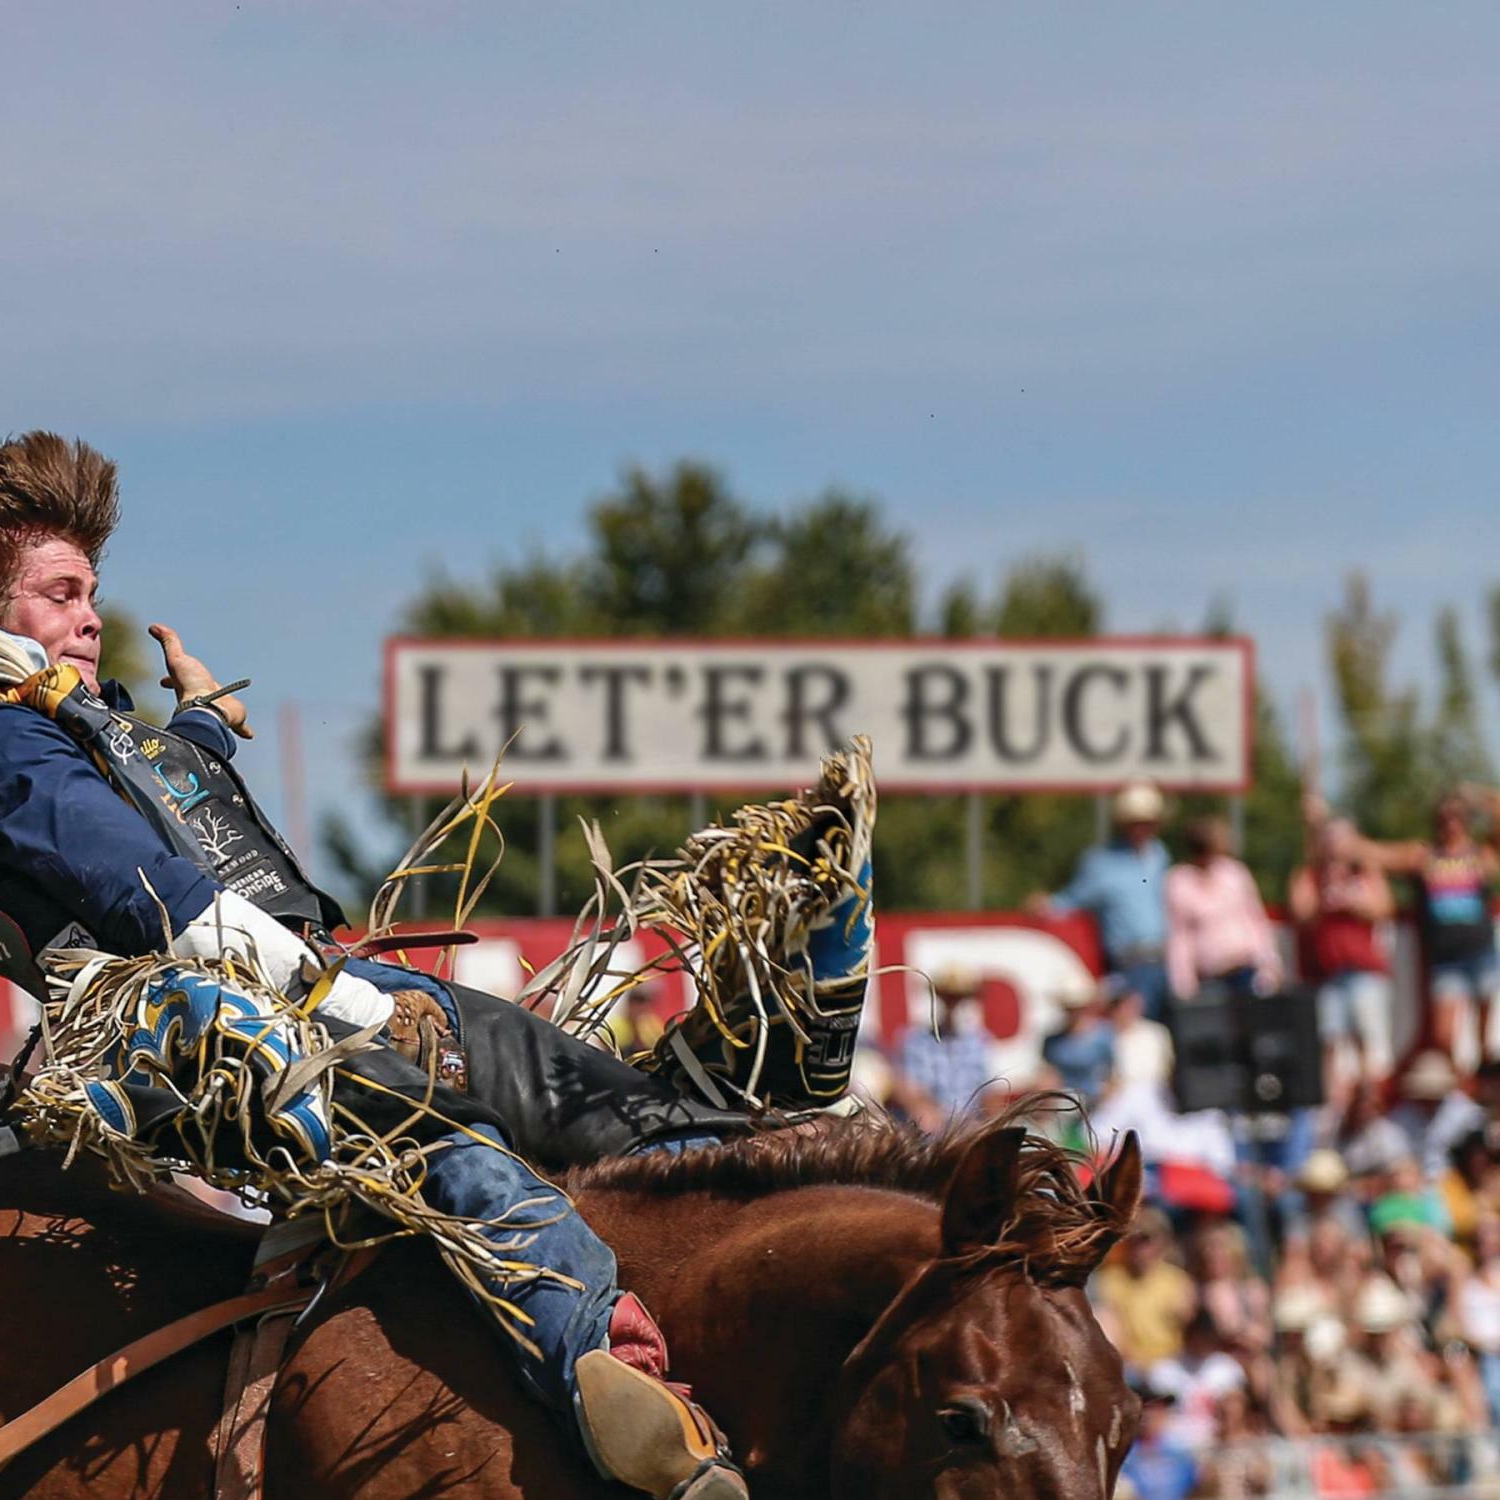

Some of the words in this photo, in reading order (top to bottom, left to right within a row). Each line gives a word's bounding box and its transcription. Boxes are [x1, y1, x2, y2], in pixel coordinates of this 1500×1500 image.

[416, 661, 856, 764] LET'ER
[900, 660, 1221, 765] BUCK
[225, 868, 266, 891] MERICAN
[236, 870, 282, 899] ONFIRE
